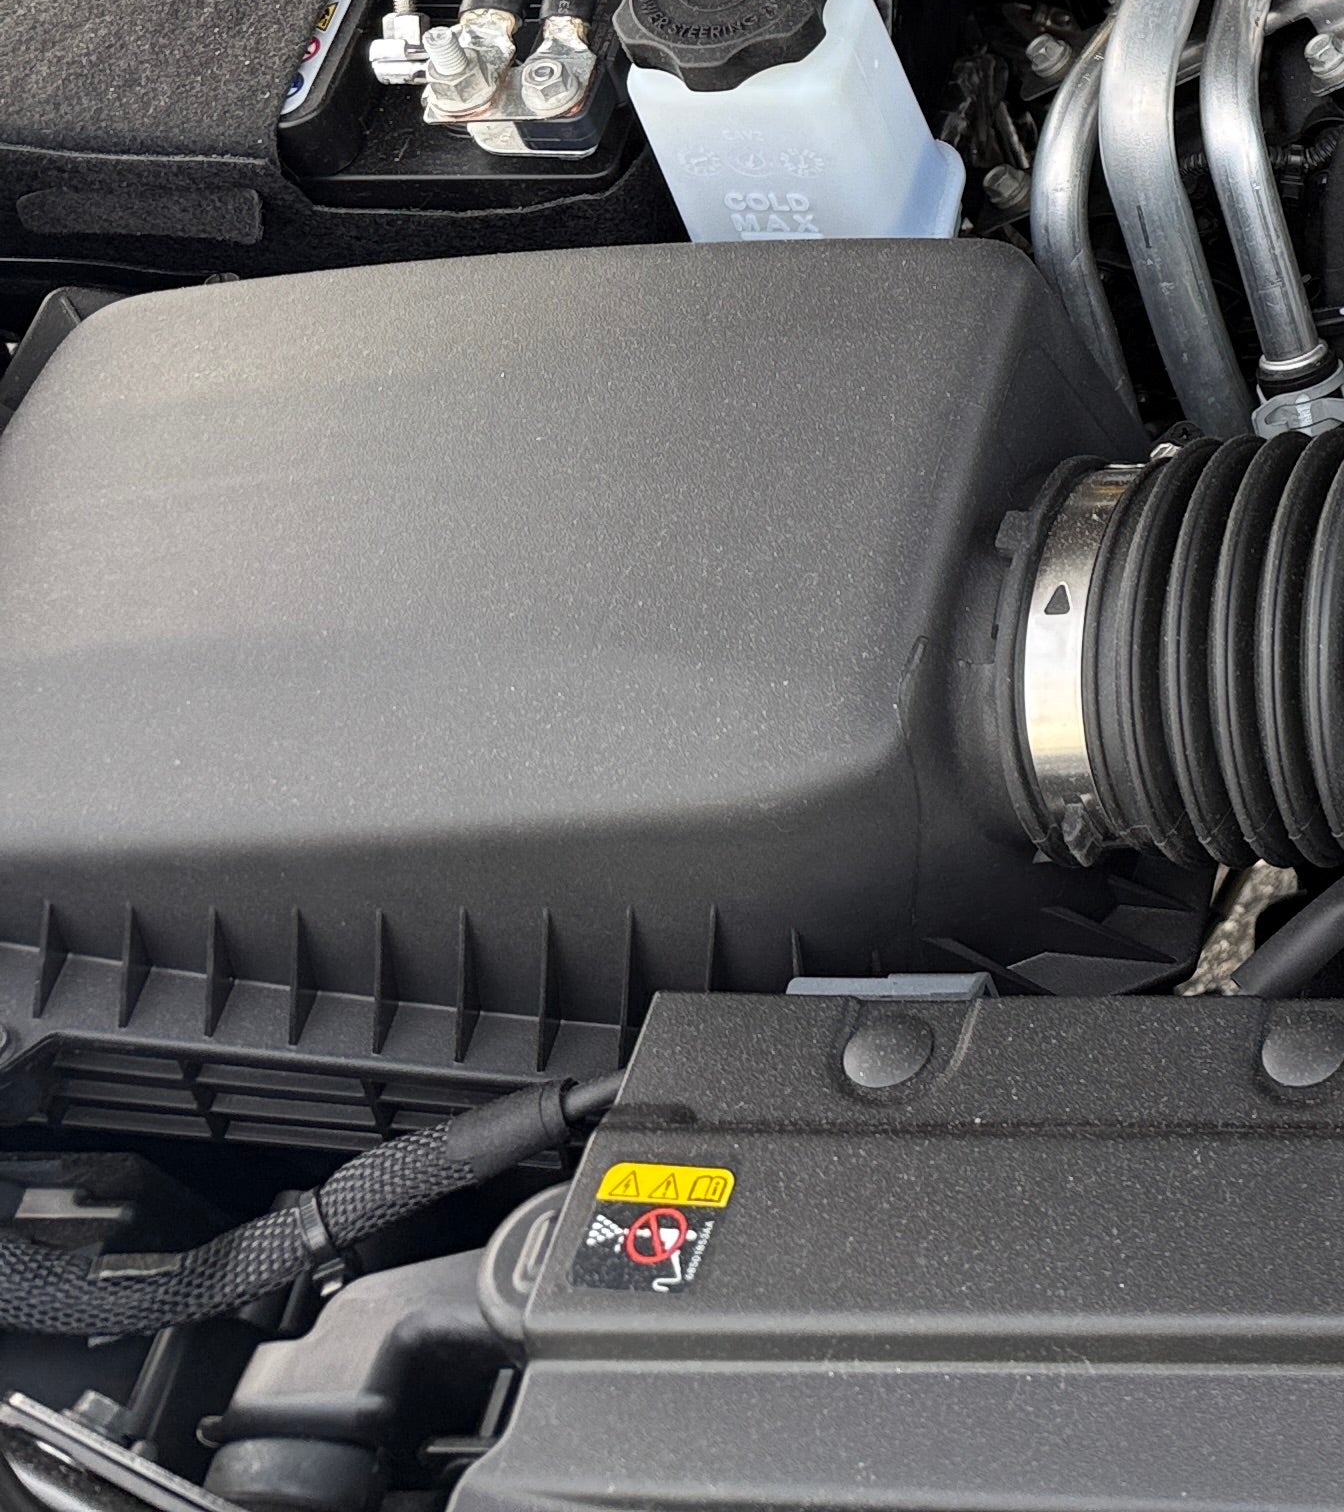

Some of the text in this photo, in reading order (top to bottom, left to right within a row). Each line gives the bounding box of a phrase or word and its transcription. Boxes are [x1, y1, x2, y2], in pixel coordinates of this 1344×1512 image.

[667, 14, 759, 40] STEERING
[723, 191, 811, 213] COLD
[730, 213, 820, 233] MAX
